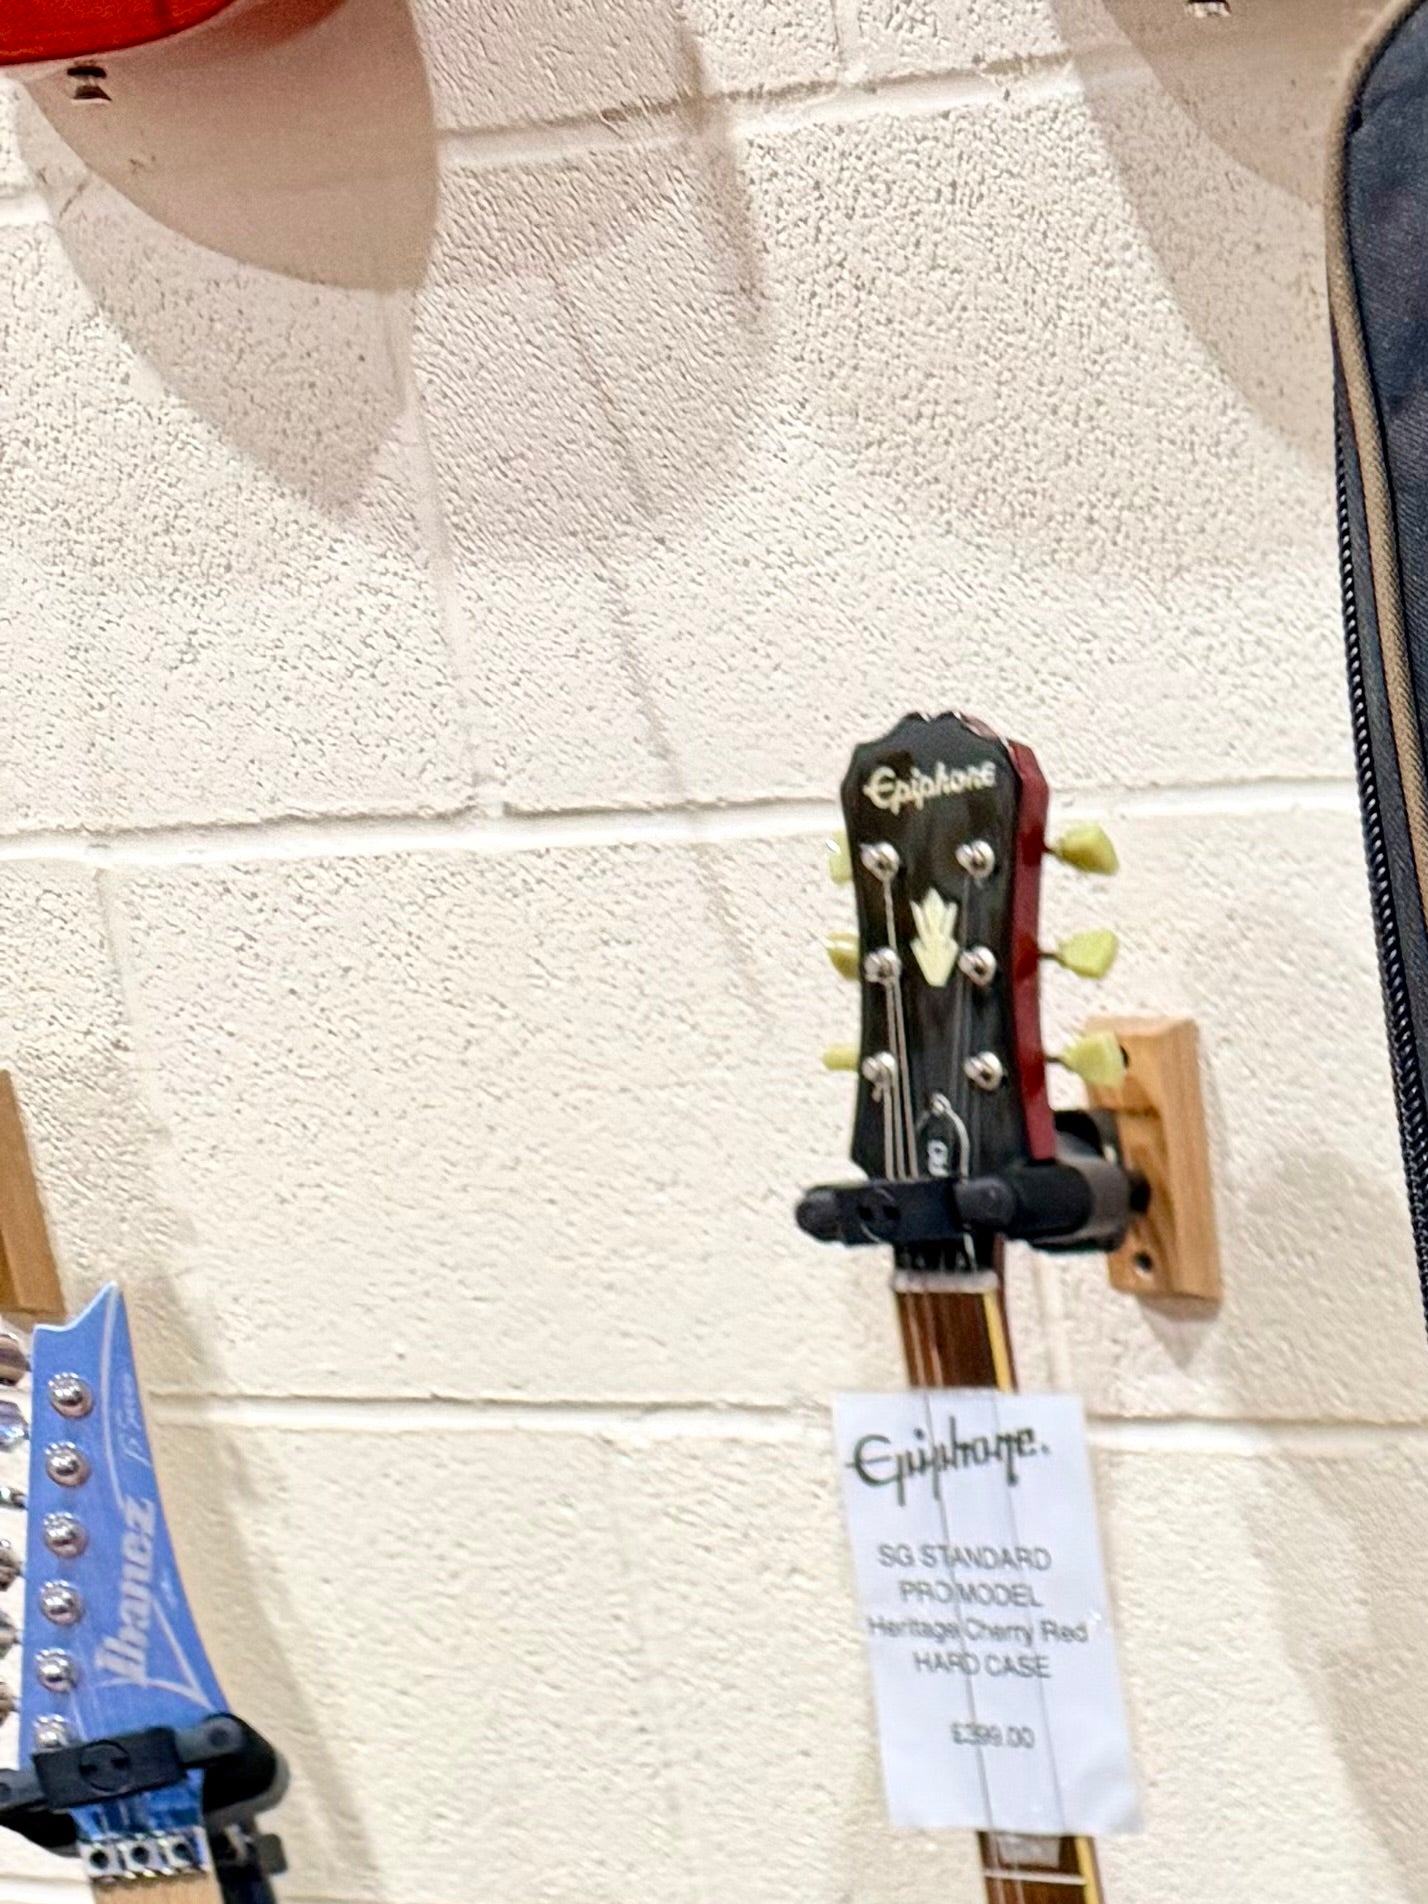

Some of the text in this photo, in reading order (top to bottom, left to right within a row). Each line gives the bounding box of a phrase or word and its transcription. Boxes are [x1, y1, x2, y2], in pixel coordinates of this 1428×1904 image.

[863, 760, 997, 816] Epiphone
[877, 1543, 1053, 1572] SG STANDARD
[95, 1495, 156, 1687] Ibanez
[899, 1579, 1044, 1608] PRO MODEL
[867, 1614, 1089, 1648] Heritage Cherry Red
[912, 1650, 1053, 1679] HARD CASE
